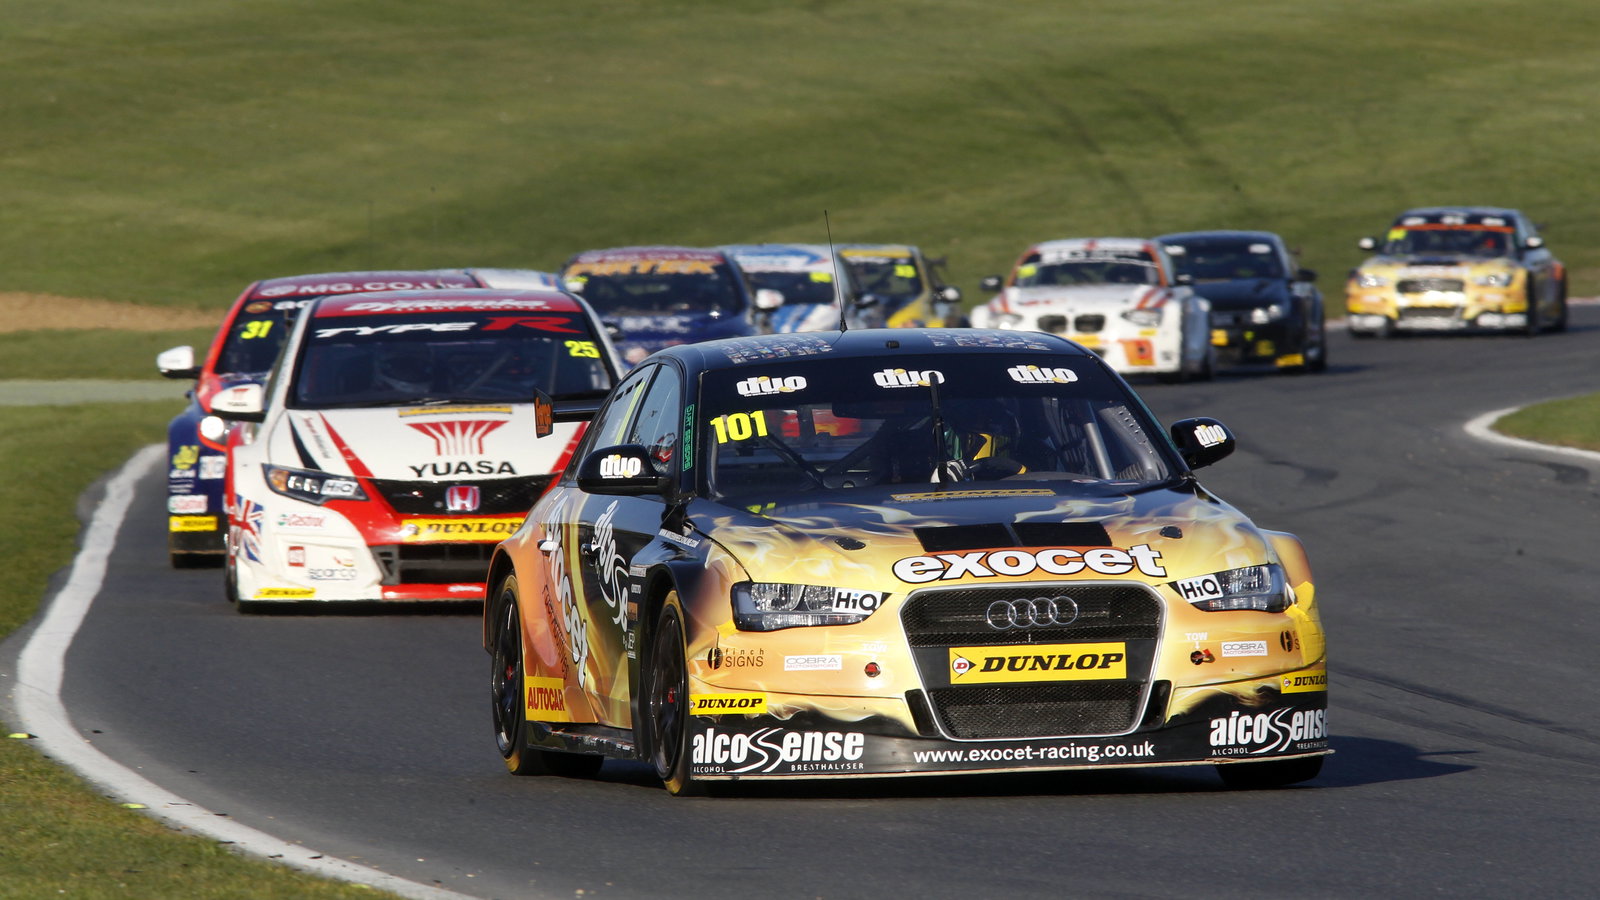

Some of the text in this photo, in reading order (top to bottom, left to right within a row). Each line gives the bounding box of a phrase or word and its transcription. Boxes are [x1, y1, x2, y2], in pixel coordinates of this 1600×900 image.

[240, 320, 274, 339] 31
[315, 316, 584, 338] TYPE R
[564, 341, 600, 358] 25
[1007, 365, 1078, 383] duo
[736, 376, 807, 397] duo
[710, 410, 768, 444] 101
[409, 460, 518, 478] YUASA
[892, 543, 1168, 584] exocet
[1180, 578, 1220, 600] HiQ
[835, 591, 879, 612] HiQ
[1185, 632, 1208, 641] TOW
[725, 656, 764, 667] SIGNS
[979, 653, 1124, 674] DUNLOP
[1293, 676, 1328, 687] DUNLO
[527, 686, 566, 712] AUTOCAR
[697, 698, 763, 709] DUNLOP
[913, 740, 1155, 763] www.exocet-racing.co.uk
[790, 762, 864, 772] BREATHALYSER
